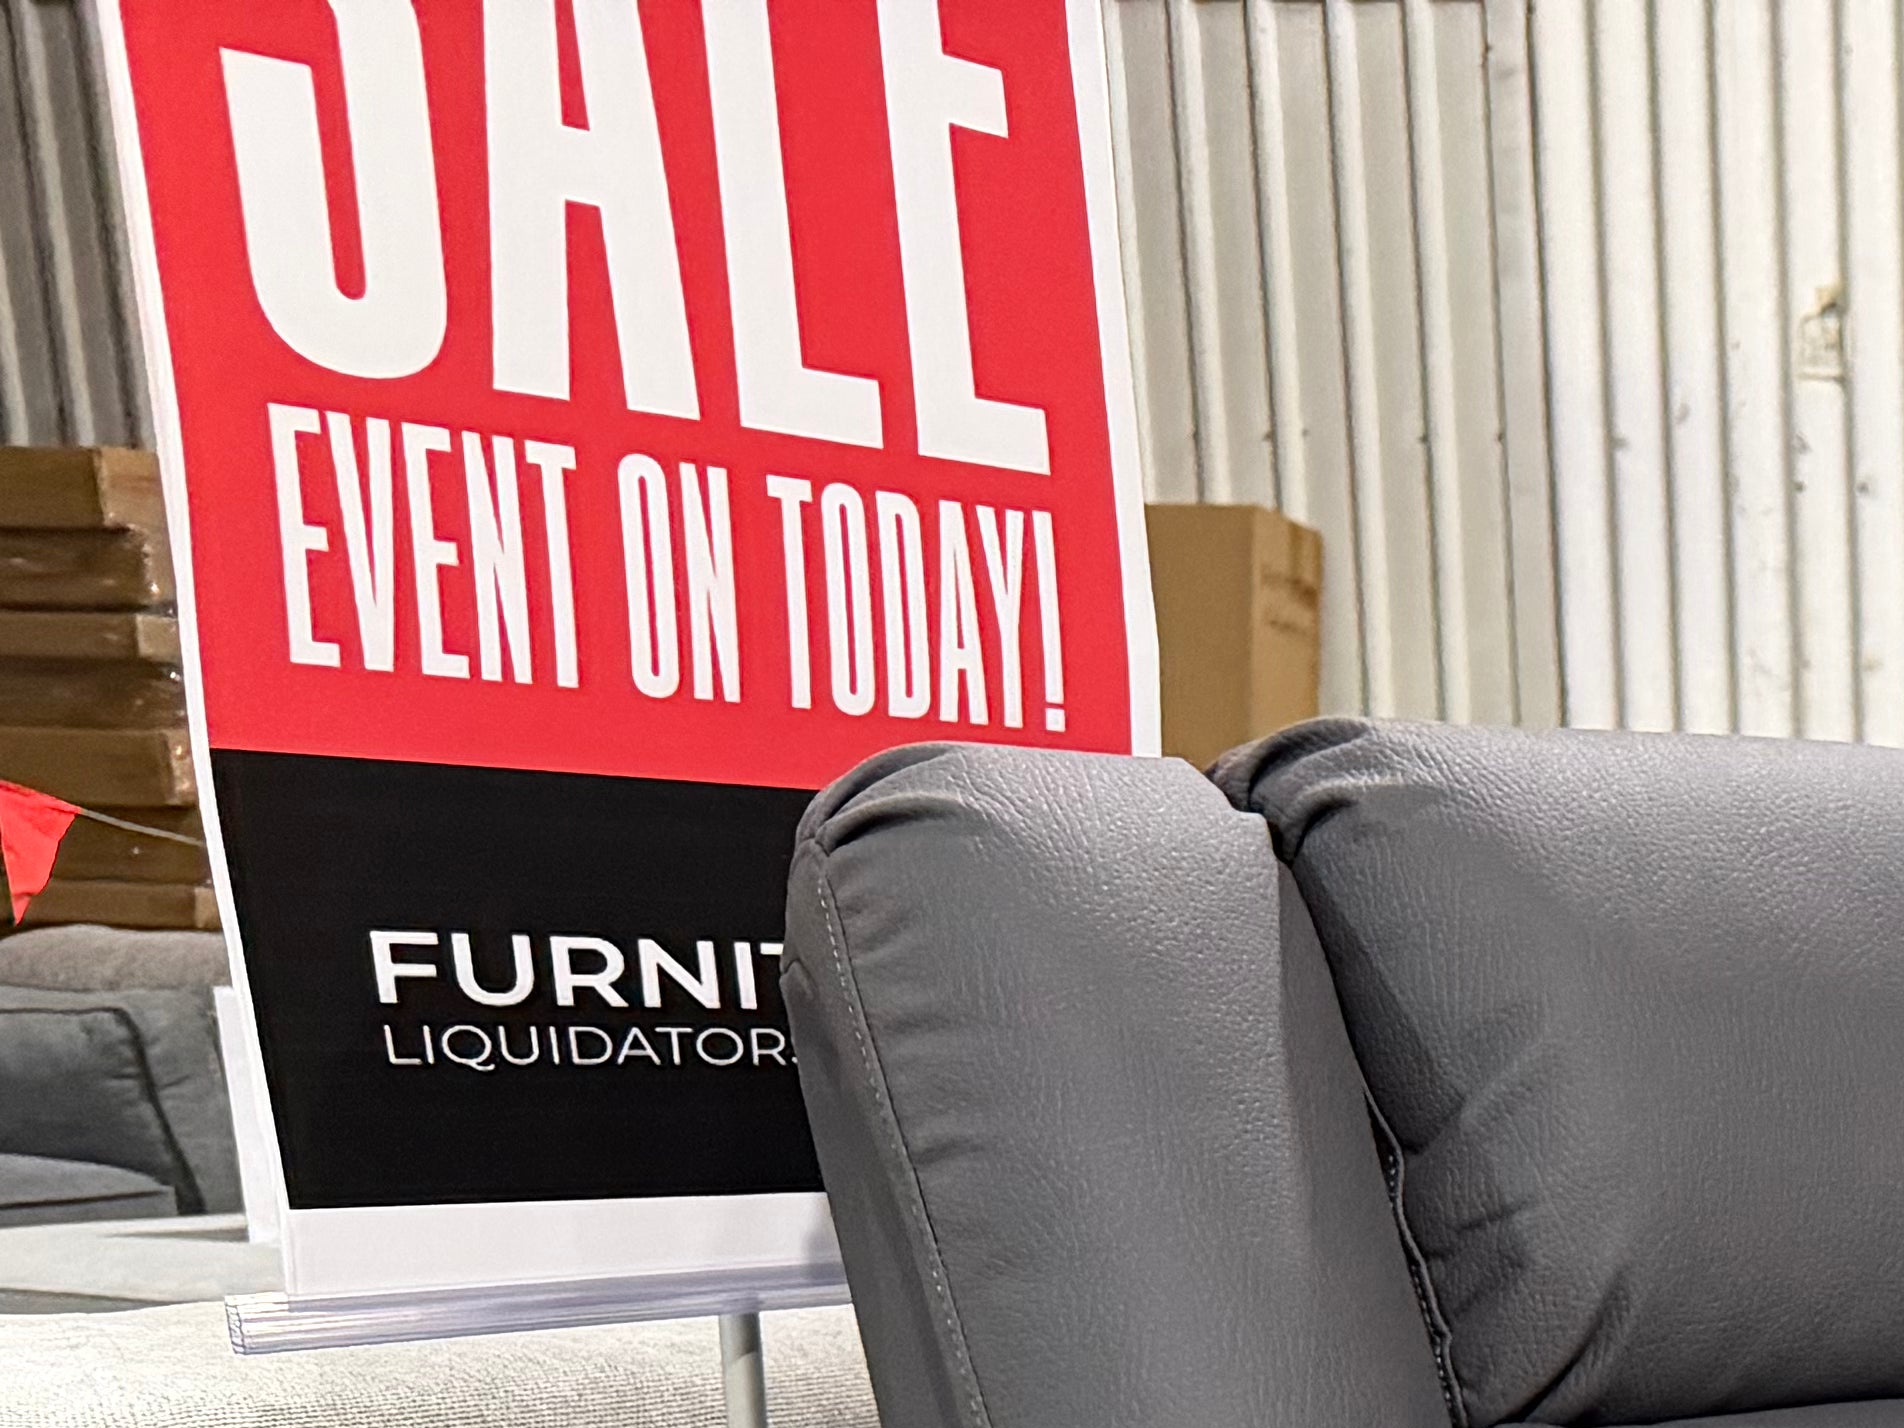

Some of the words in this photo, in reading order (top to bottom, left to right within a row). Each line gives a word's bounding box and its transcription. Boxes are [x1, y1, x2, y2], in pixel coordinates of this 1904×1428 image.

[267, 402, 580, 689] EVENT
[616, 452, 742, 704] ON
[765, 473, 1066, 733] TODAY!
[369, 929, 784, 1010] FURNI
[383, 1024, 798, 1071] LIQUIDATOR
